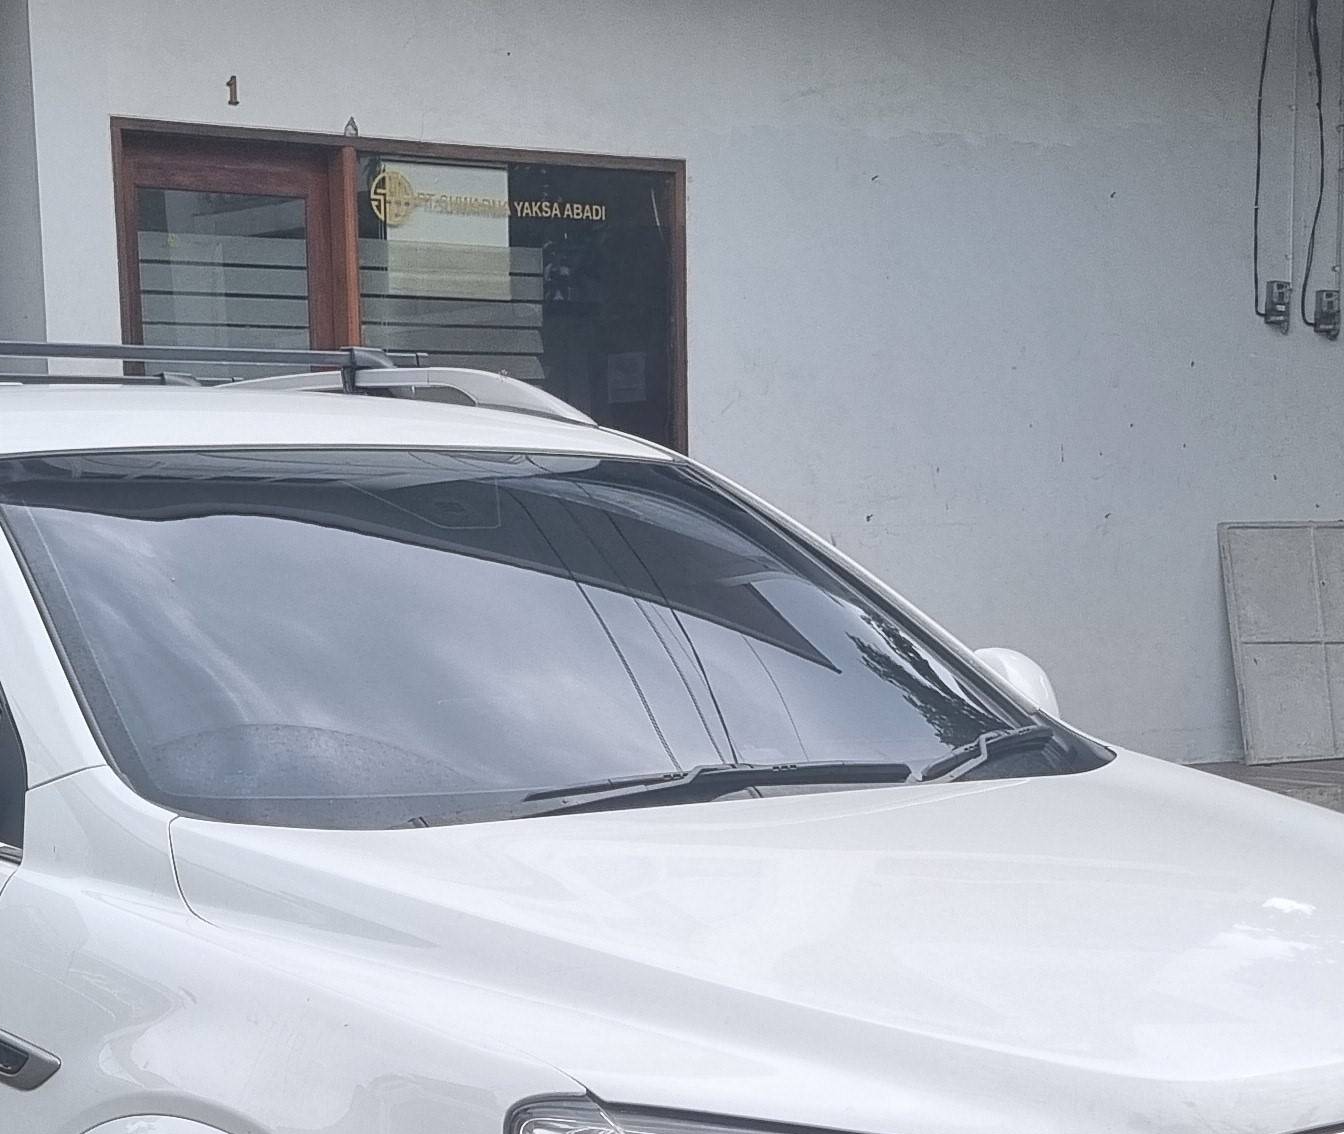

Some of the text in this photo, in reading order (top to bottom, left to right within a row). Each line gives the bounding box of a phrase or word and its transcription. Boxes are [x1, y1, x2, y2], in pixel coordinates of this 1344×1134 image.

[226, 75, 240, 106] 1
[514, 201, 561, 218] YAKSA
[563, 203, 606, 221] ABADI
